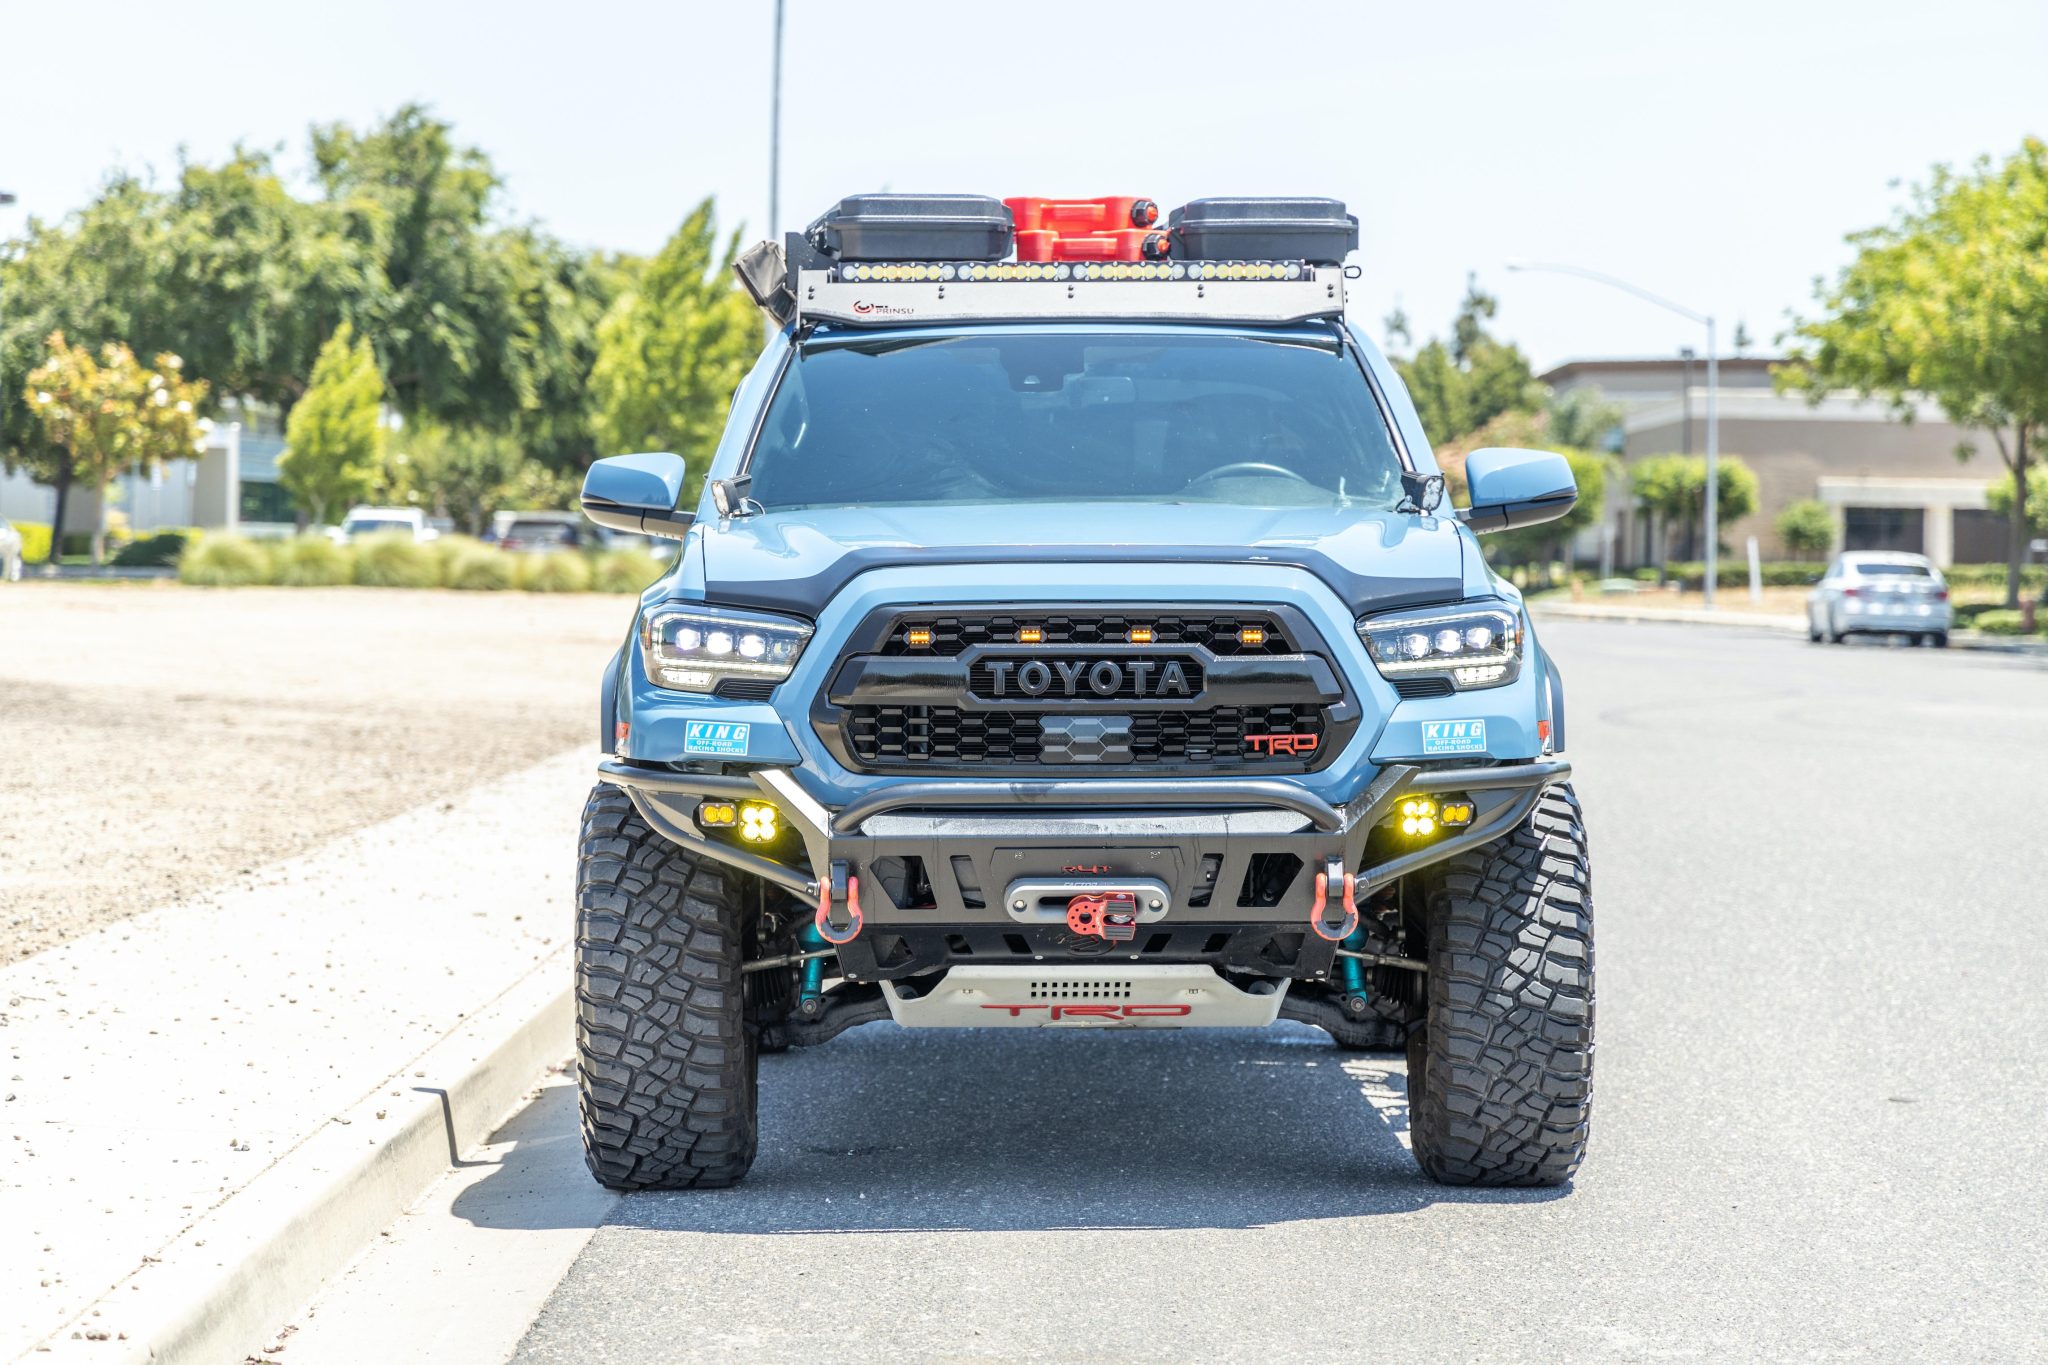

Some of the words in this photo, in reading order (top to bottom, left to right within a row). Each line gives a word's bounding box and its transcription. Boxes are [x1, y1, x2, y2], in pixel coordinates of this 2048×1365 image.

[876, 308, 914, 316] PRINSU
[985, 660, 1191, 696] TOYOTA
[690, 724, 747, 740] KING
[1427, 722, 1482, 738] KING
[1244, 734, 1318, 756] TRD
[980, 1004, 1192, 1021] TRD
